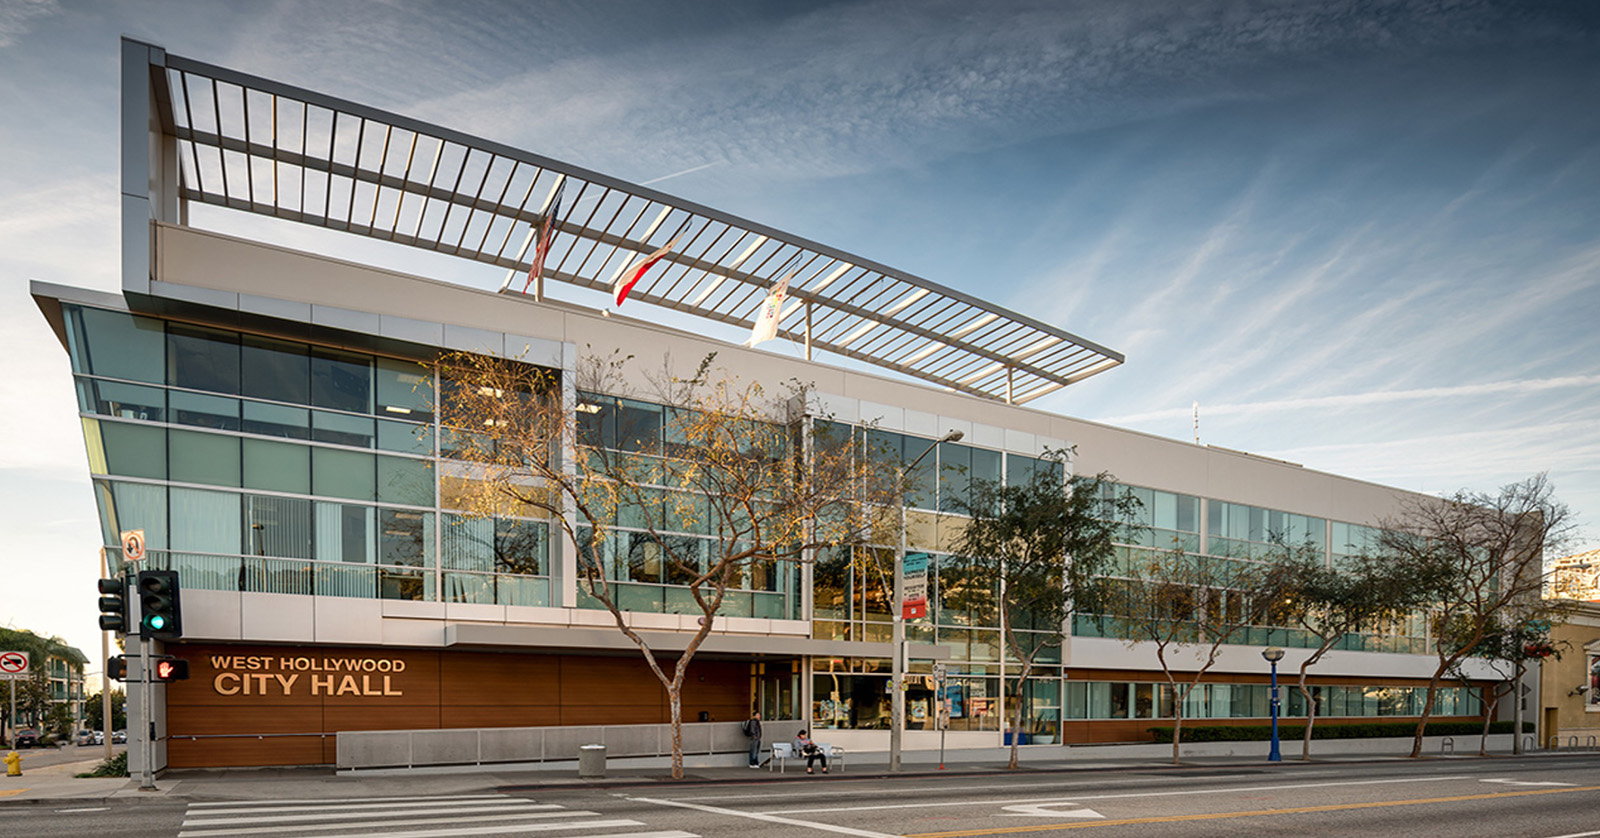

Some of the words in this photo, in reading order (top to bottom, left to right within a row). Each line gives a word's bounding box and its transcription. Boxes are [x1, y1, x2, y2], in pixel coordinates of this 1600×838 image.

[211, 656, 274, 670] WEST
[280, 657, 406, 673] HOLLYWOOD
[214, 673, 299, 695] CITY
[311, 674, 403, 696] HALL
